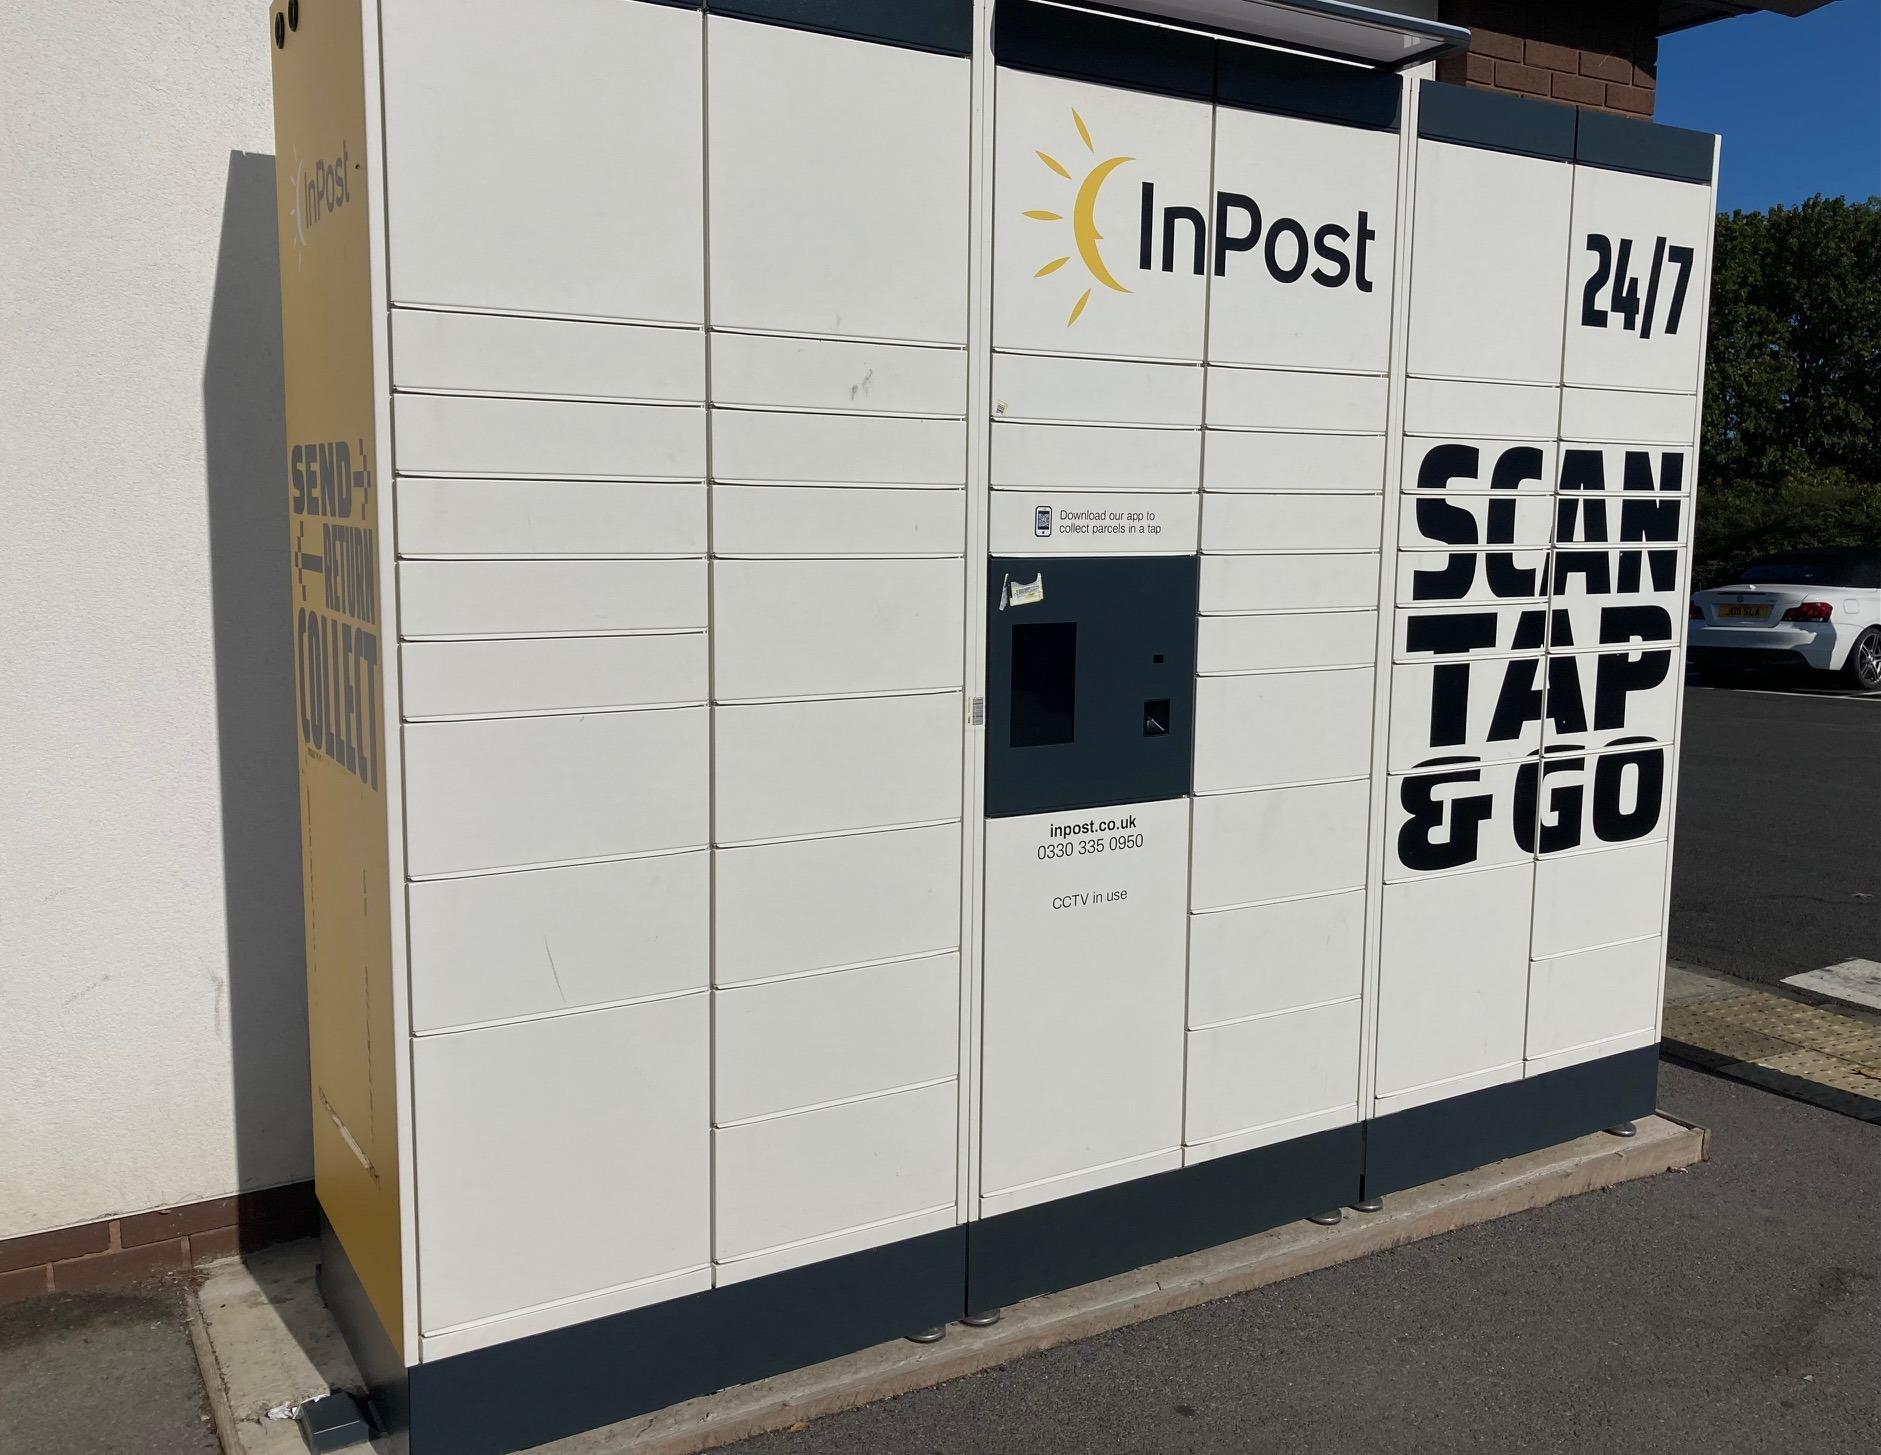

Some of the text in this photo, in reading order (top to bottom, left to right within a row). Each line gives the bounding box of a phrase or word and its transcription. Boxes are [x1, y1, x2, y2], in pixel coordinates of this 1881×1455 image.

[304, 139, 350, 229] InPost
[1139, 181, 1376, 293] InPost
[1581, 233, 1694, 339] 24/7
[291, 441, 352, 518] SEND
[1060, 510, 1156, 522] Download our app to
[1412, 444, 1684, 601] SCAN
[322, 523, 376, 625] RETURN
[1059, 523, 1162, 536] collect parcels in a tap
[298, 606, 379, 793] COLLECT
[1406, 605, 1673, 748] TAP
[1037, 833, 1144, 860] 0330 335 0950
[1050, 815, 1137, 838] inpost.co.uk
[1397, 735, 1665, 871] & GO
[1052, 889, 1128, 909] CCTV in use
